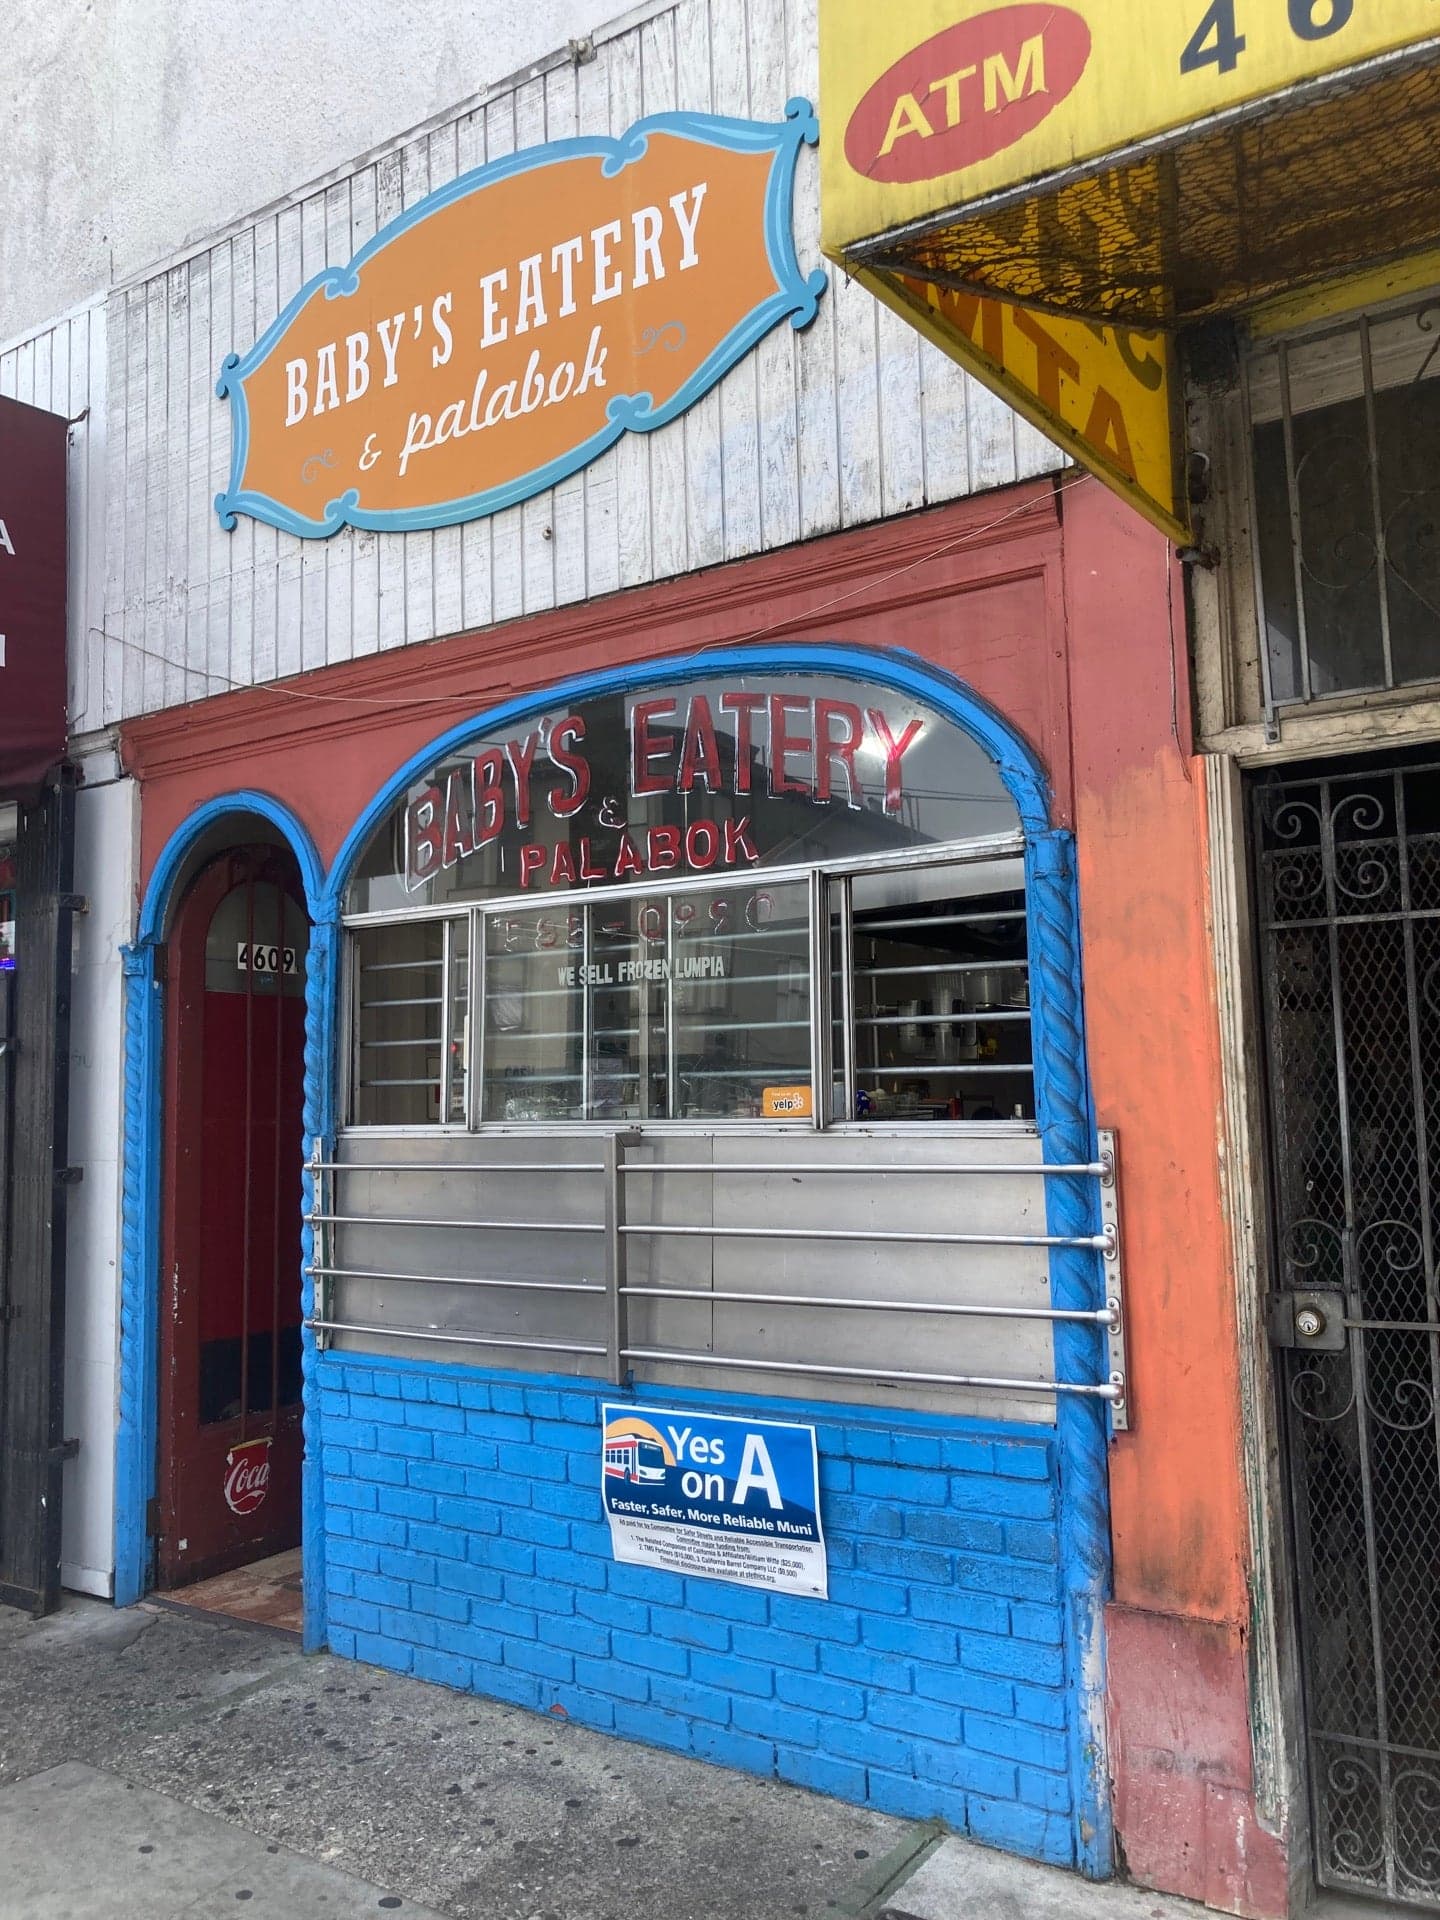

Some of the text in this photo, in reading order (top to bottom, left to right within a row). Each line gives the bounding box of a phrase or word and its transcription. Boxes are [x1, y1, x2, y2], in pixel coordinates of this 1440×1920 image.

[878, 33, 1049, 157] ATM
[285, 182, 707, 427] BABY'S EATERY
[358, 325, 608, 476] & palabok
[404, 692, 924, 893] BABY'S EATERY
[599, 796, 628, 829] &
[520, 816, 760, 889] PALABOK
[239, 944, 294, 973] 4609
[558, 956, 725, 986] WE SELL FROZEN LUMPIA
[773, 1098, 793, 1110] yelp
[667, 1425, 725, 1465] Yes
[226, 1458, 270, 1504] Coca
[681, 1433, 784, 1510] on A
[611, 1497, 812, 1535] Faster, Safer, More Reliable Muni
